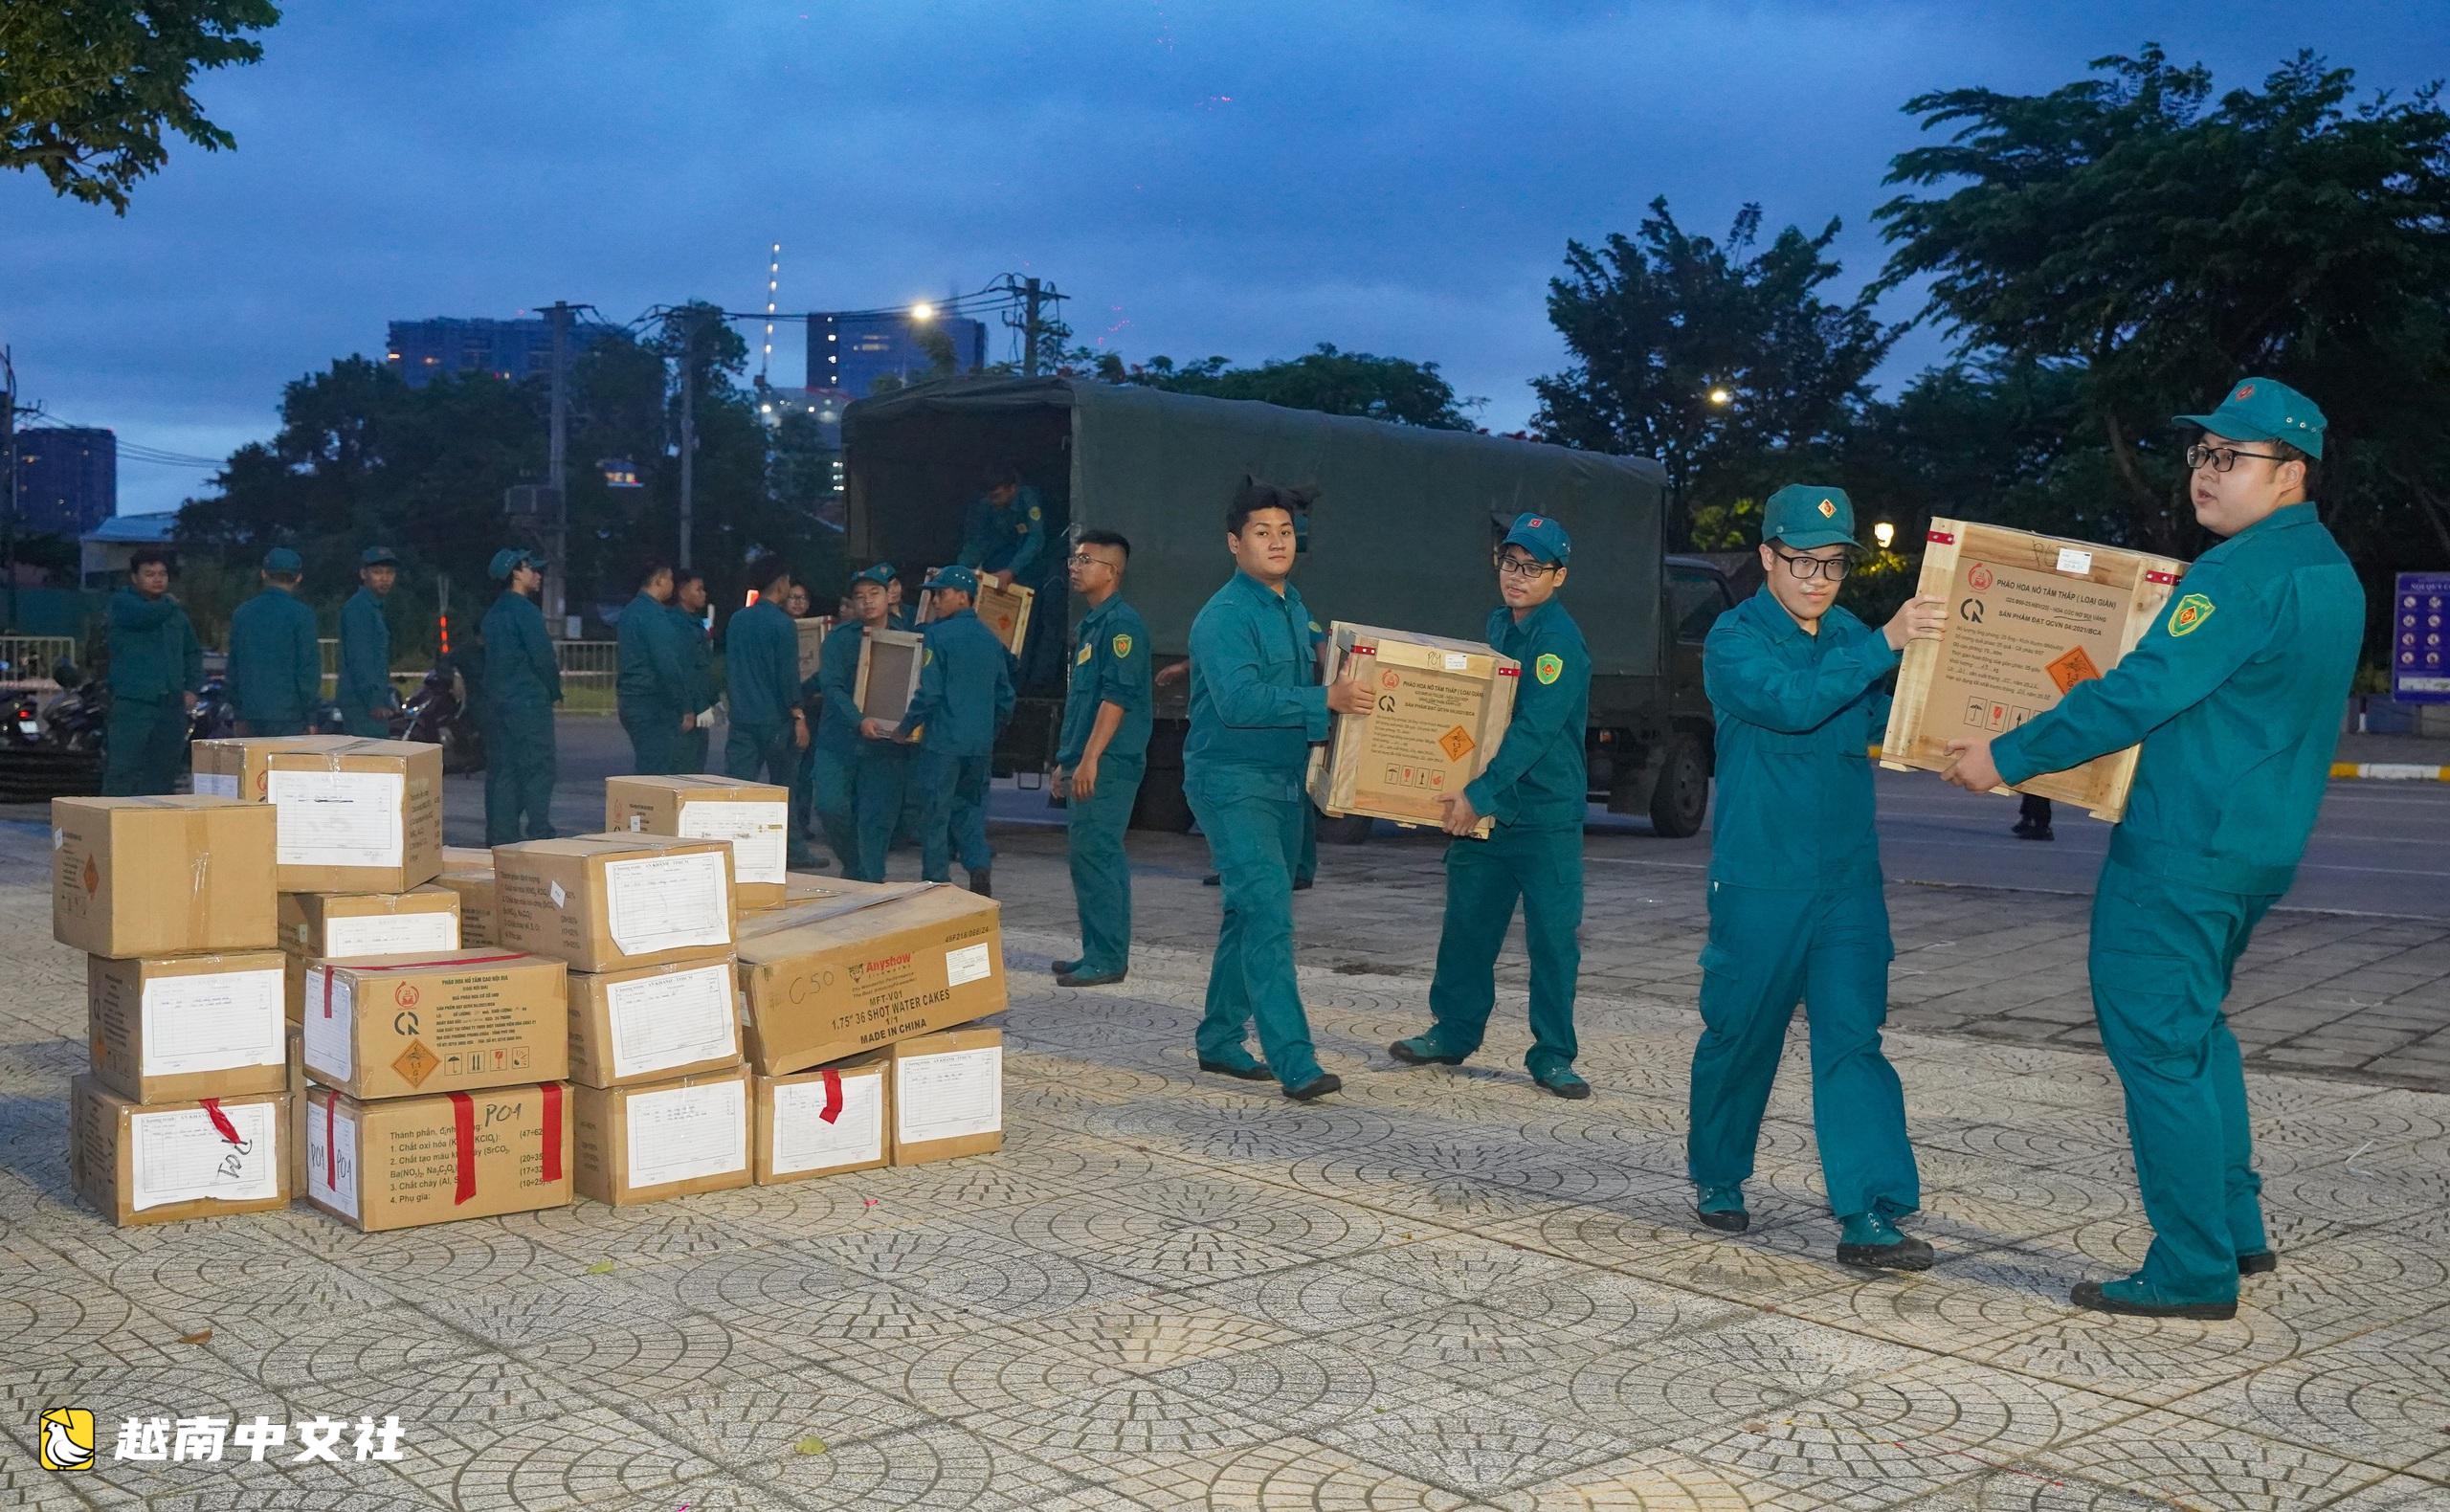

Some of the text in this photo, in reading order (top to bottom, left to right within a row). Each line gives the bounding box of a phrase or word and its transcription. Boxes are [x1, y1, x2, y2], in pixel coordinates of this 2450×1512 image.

[2016, 584, 2030, 592] HOA
[866, 953, 911, 973] Anyshow
[869, 990, 903, 1006] MFT-V01
[856, 1011, 866, 1025] 36
[867, 1005, 889, 1022] SHOT
[892, 997, 921, 1015] WATER
[923, 989, 950, 1006] CAKES
[860, 1018, 927, 1044] MADE IN CHINA
[390, 1130, 414, 1140] Thành
[399, 1142, 417, 1151] Chất
[419, 1141, 431, 1150] oxi
[399, 1154, 417, 1164] Chất
[399, 1181, 417, 1190] Chất
[416, 1193, 431, 1202] gia:
